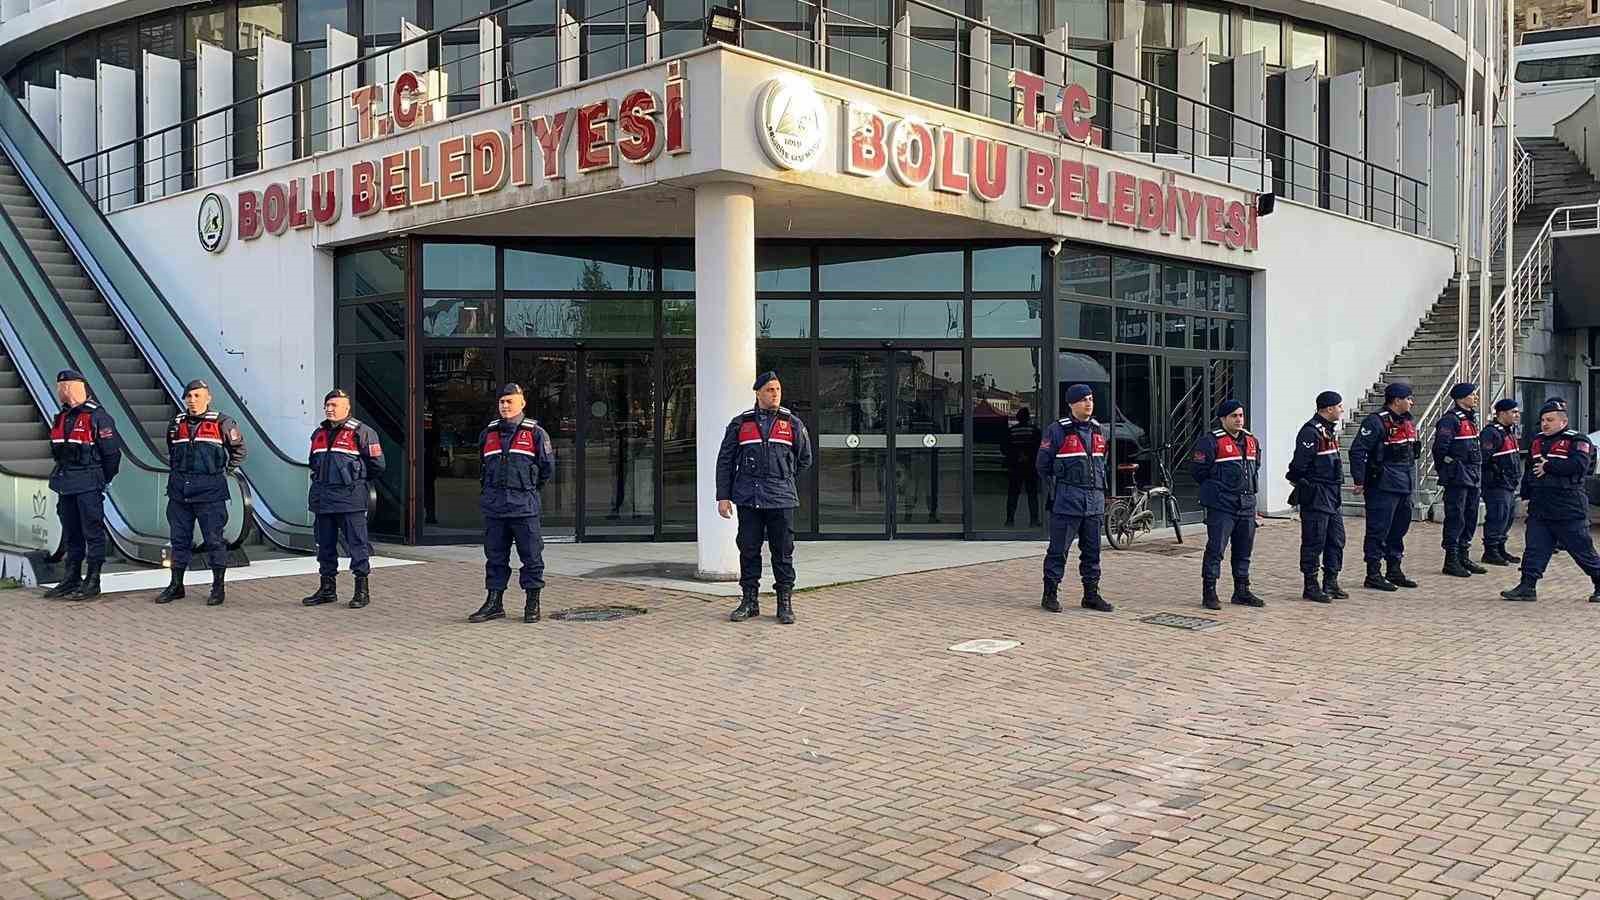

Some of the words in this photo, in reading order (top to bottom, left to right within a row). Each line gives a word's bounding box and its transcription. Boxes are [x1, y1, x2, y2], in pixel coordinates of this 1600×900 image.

[237, 170, 339, 241] BOLU
[352, 61, 687, 217] BELEDİYESİ
[352, 70, 434, 141] T.C.
[1012, 69, 1104, 149] T.C.
[846, 107, 1008, 202] BOLU
[1024, 151, 1259, 251] BELEDİYESİ
